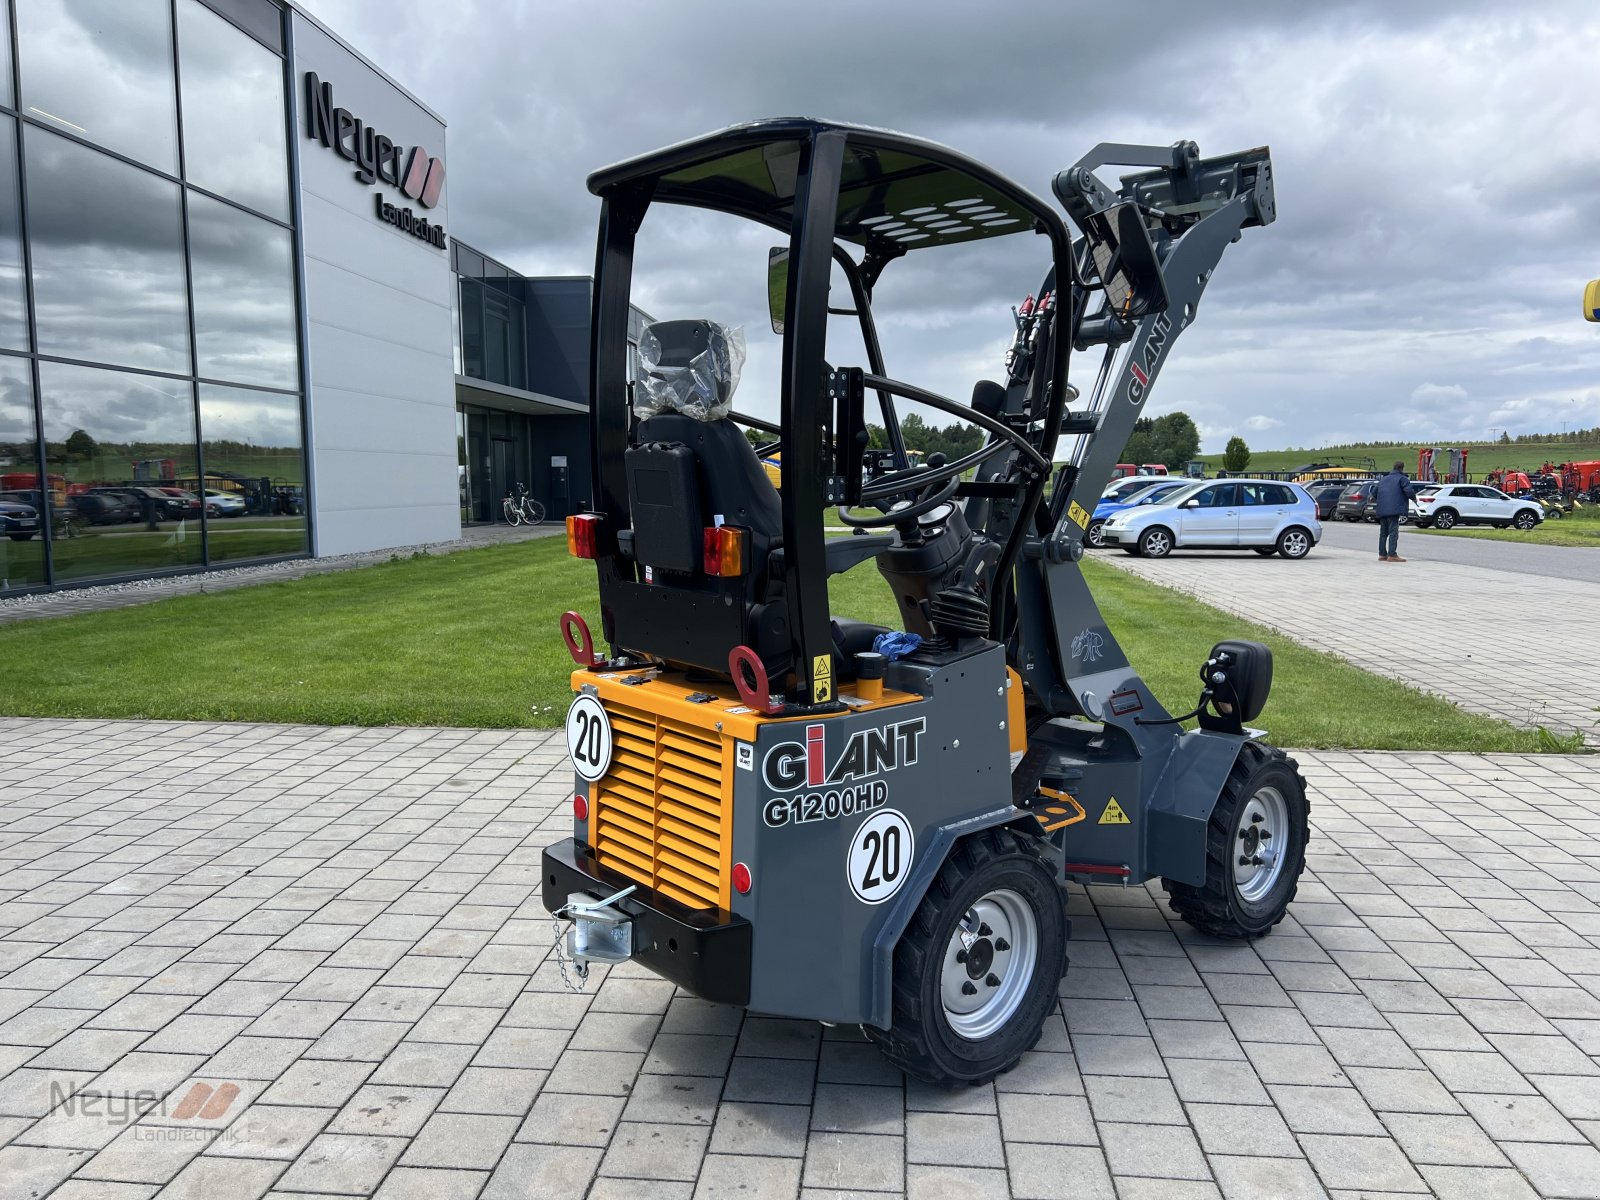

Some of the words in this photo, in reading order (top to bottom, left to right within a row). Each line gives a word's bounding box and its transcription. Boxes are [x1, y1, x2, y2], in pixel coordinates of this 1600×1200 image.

[305, 72, 403, 188] Neyer
[375, 193, 447, 250] Landtechnik
[575, 709, 601, 768] 20
[763, 780, 888, 827] G1200HD
[861, 825, 900, 891] 20
